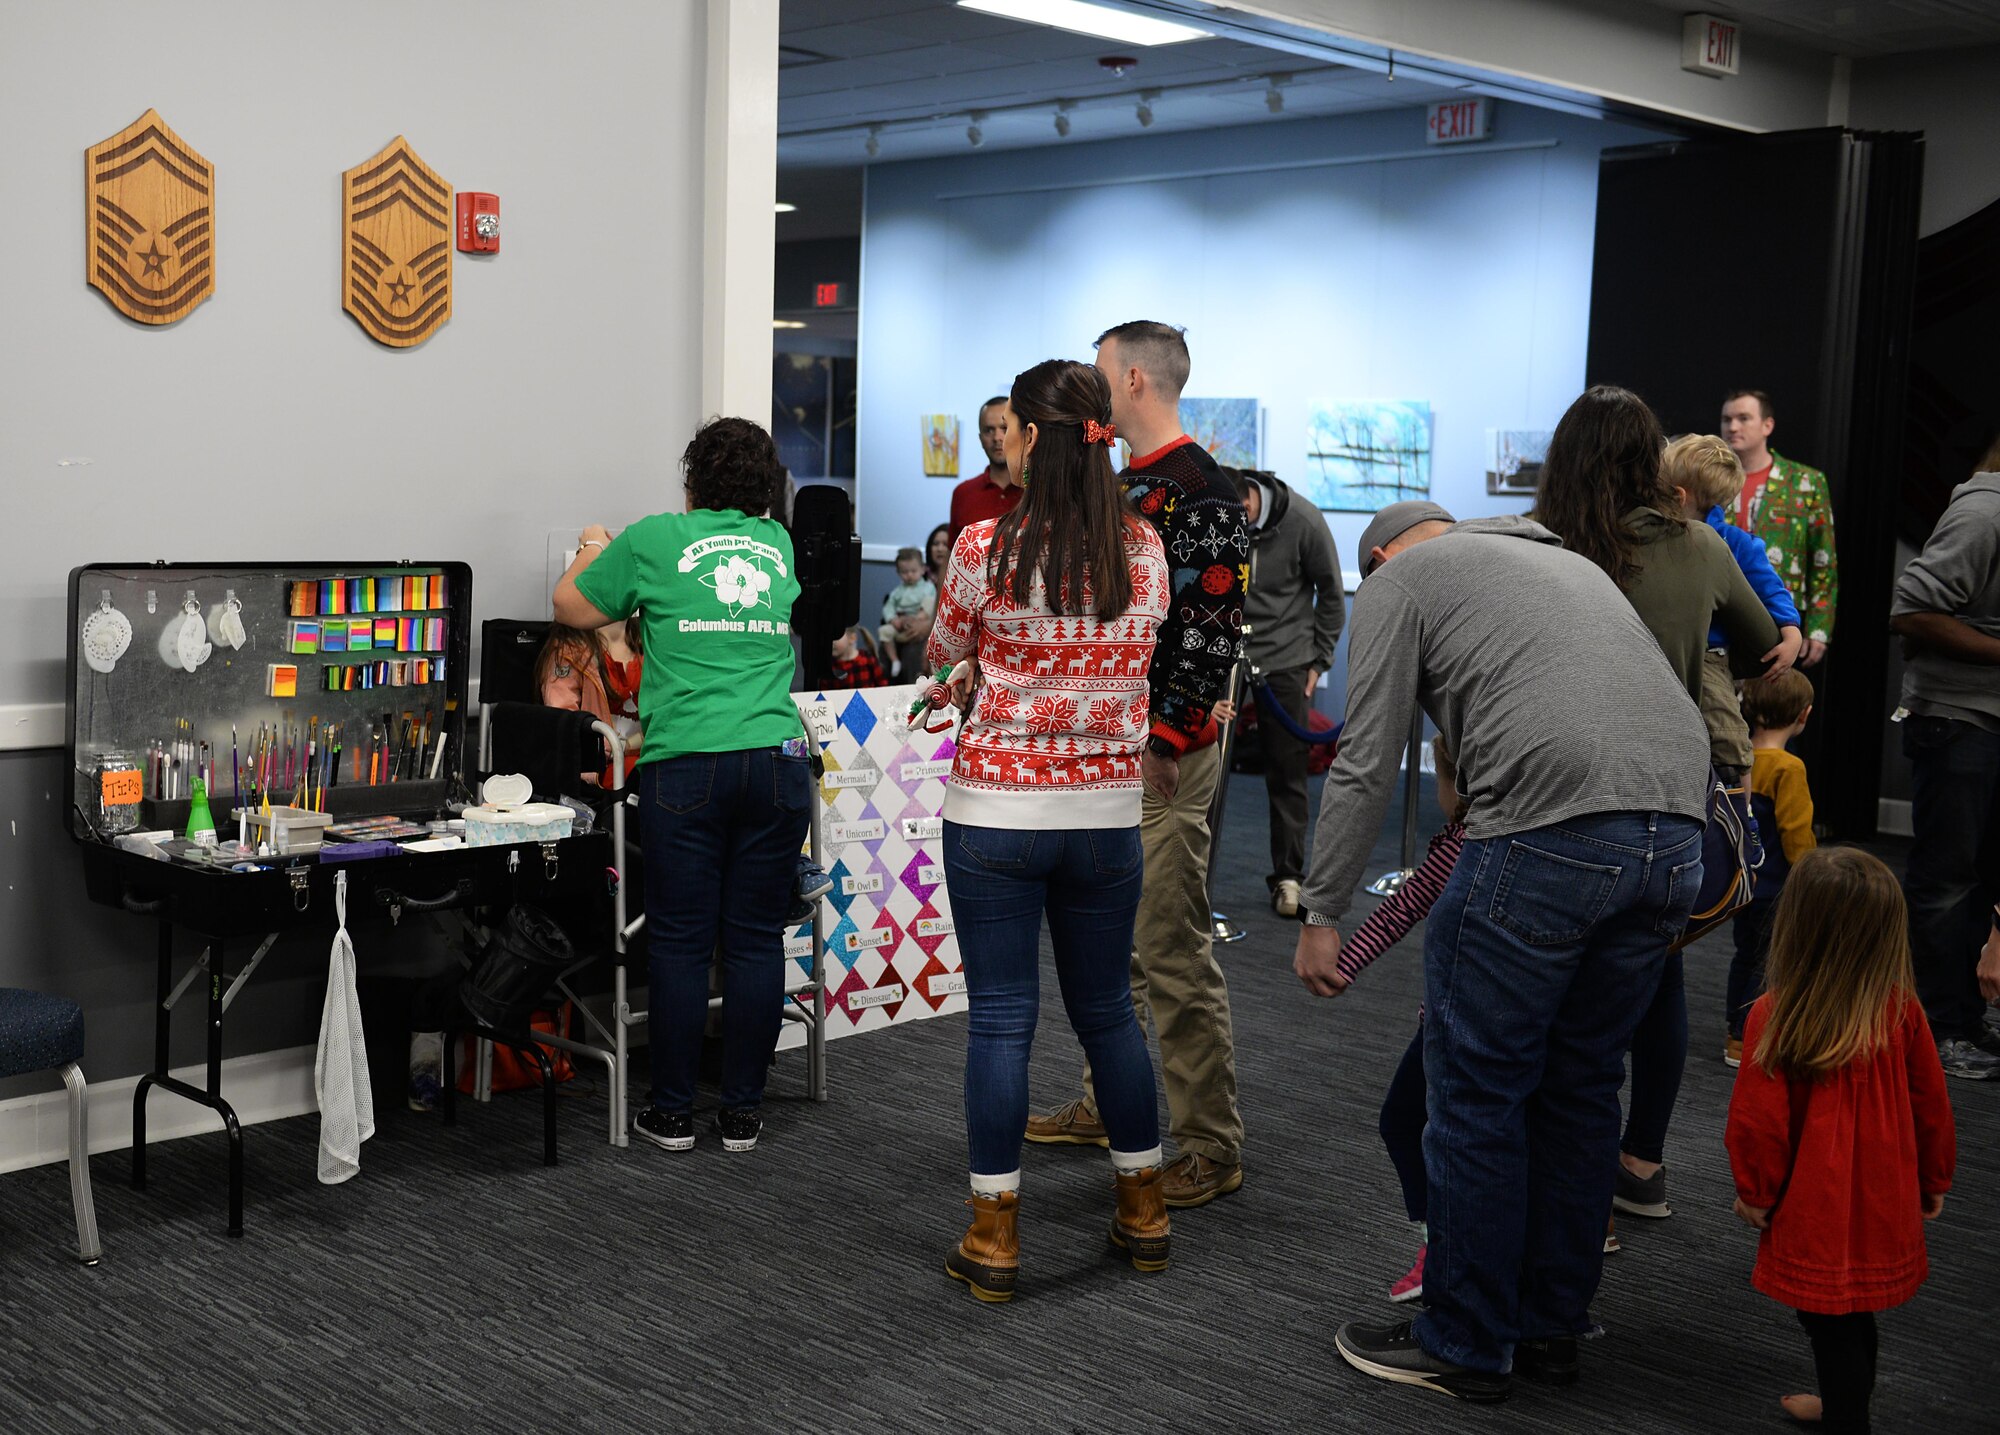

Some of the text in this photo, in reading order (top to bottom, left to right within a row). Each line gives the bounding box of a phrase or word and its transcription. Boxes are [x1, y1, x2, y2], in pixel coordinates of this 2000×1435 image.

[1707, 21, 1736, 68] EXIT
[1438, 101, 1478, 138] EXIT
[817, 284, 838, 305] EXIT
[691, 544, 706, 557] AF
[706, 538, 733, 549] Youth
[678, 619, 745, 632] Columbus
[747, 620, 775, 635] AFB,
[916, 765, 949, 776] Princess
[836, 774, 866, 784] Mermaid
[105, 779, 140, 798] TIPS
[846, 828, 873, 838] Unicorn
[920, 825, 942, 837] Pupp
[857, 881, 871, 891] Owl
[859, 936, 882, 947] Sunset
[861, 994, 892, 1005] Dinosaur
